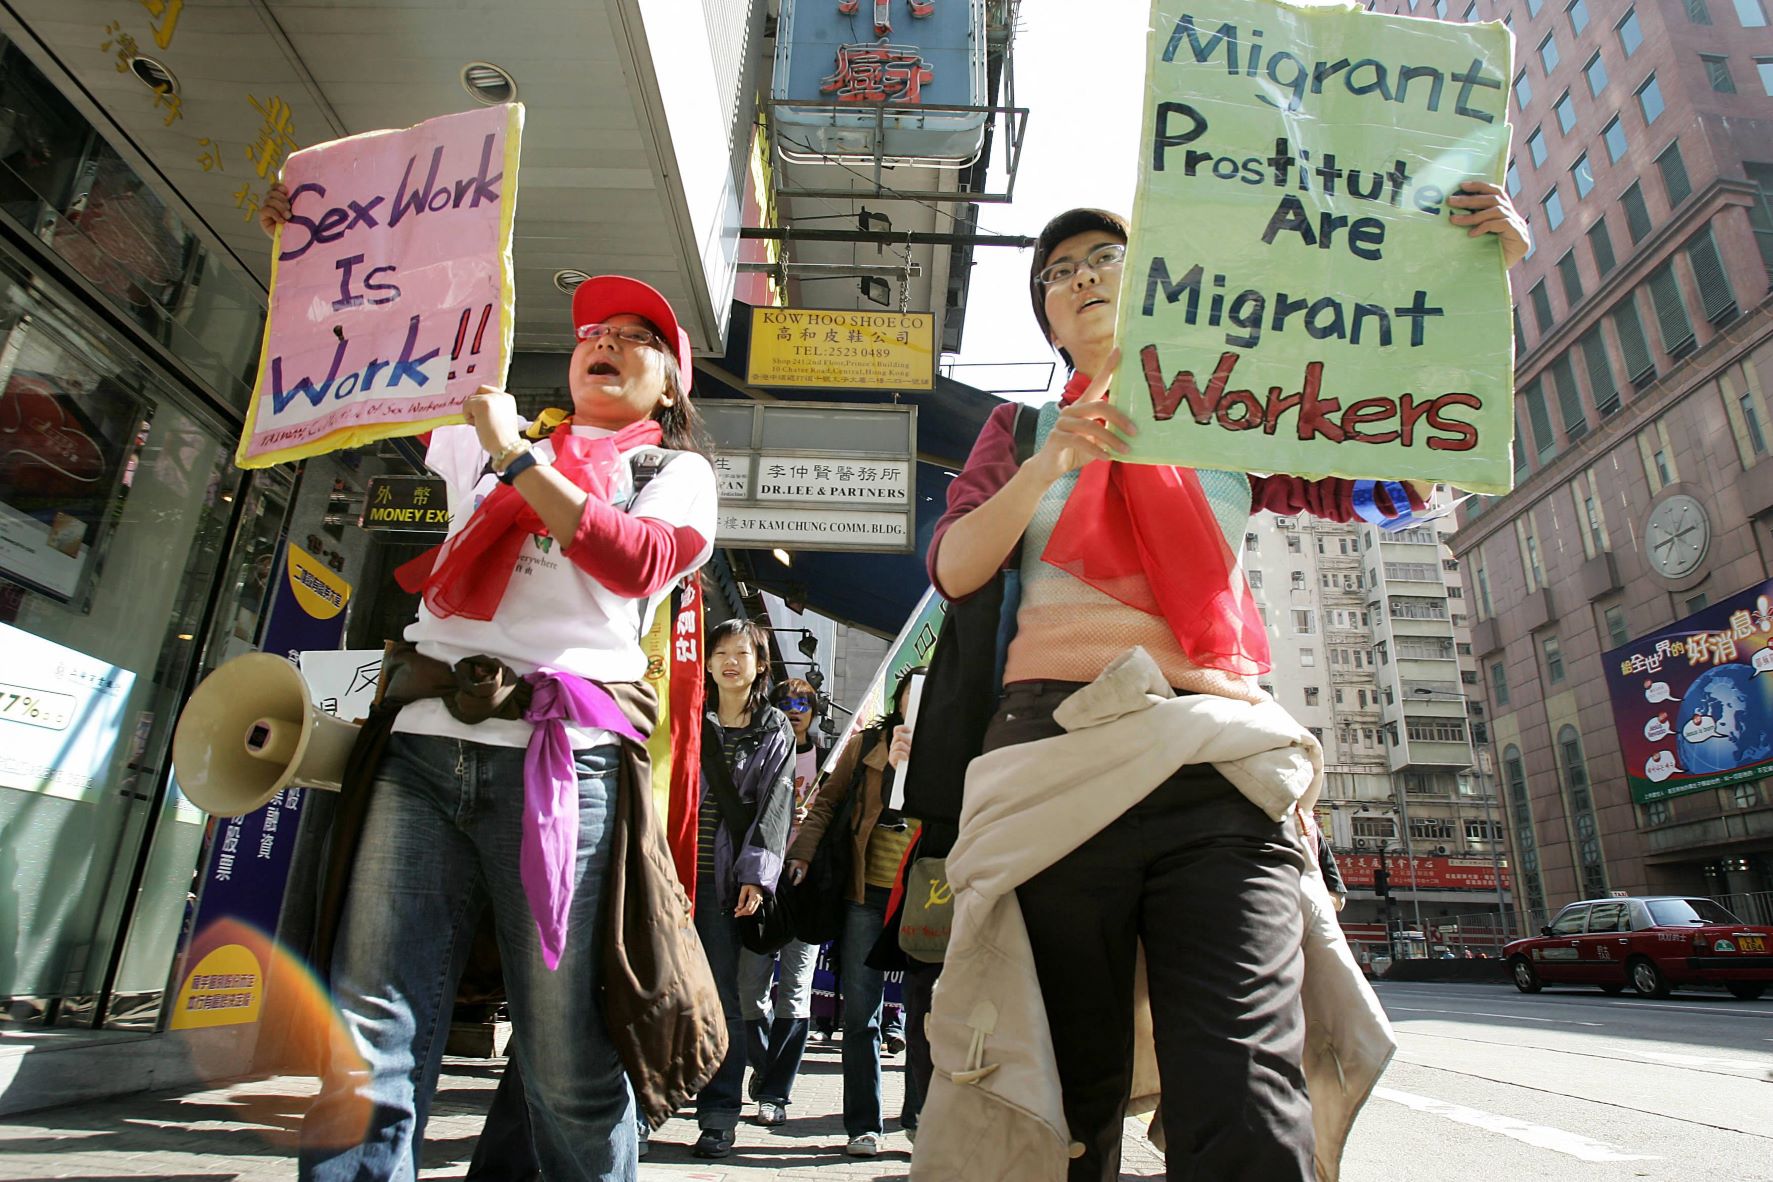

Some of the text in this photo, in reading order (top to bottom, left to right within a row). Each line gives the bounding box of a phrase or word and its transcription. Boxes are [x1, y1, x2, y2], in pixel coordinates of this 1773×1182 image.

[1161, 13, 1502, 124] Migrant
[277, 182, 385, 261] Sex
[387, 133, 504, 228] Work
[1261, 194, 1386, 260] Are
[331, 253, 401, 312] Is
[1142, 257, 1444, 348] Migrant
[763, 312, 923, 329] KOW HOO SHOE CO
[776, 326, 910, 345] 高和皮鞋公司
[861, 347, 890, 358] 0489
[772, 358, 791, 367] Shop
[1140, 344, 1482, 452] Workers
[767, 464, 902, 483] 李仲賢醫務所
[761, 484, 905, 499] DR.LEE & PARTNERS
[370, 508, 423, 522] MONEY
[740, 519, 757, 530] 3/F
[758, 520, 785, 530] KAM
[787, 521, 826, 532] CHUNG
[829, 521, 870, 533] COMM.
[872, 523, 907, 535] BLDG.
